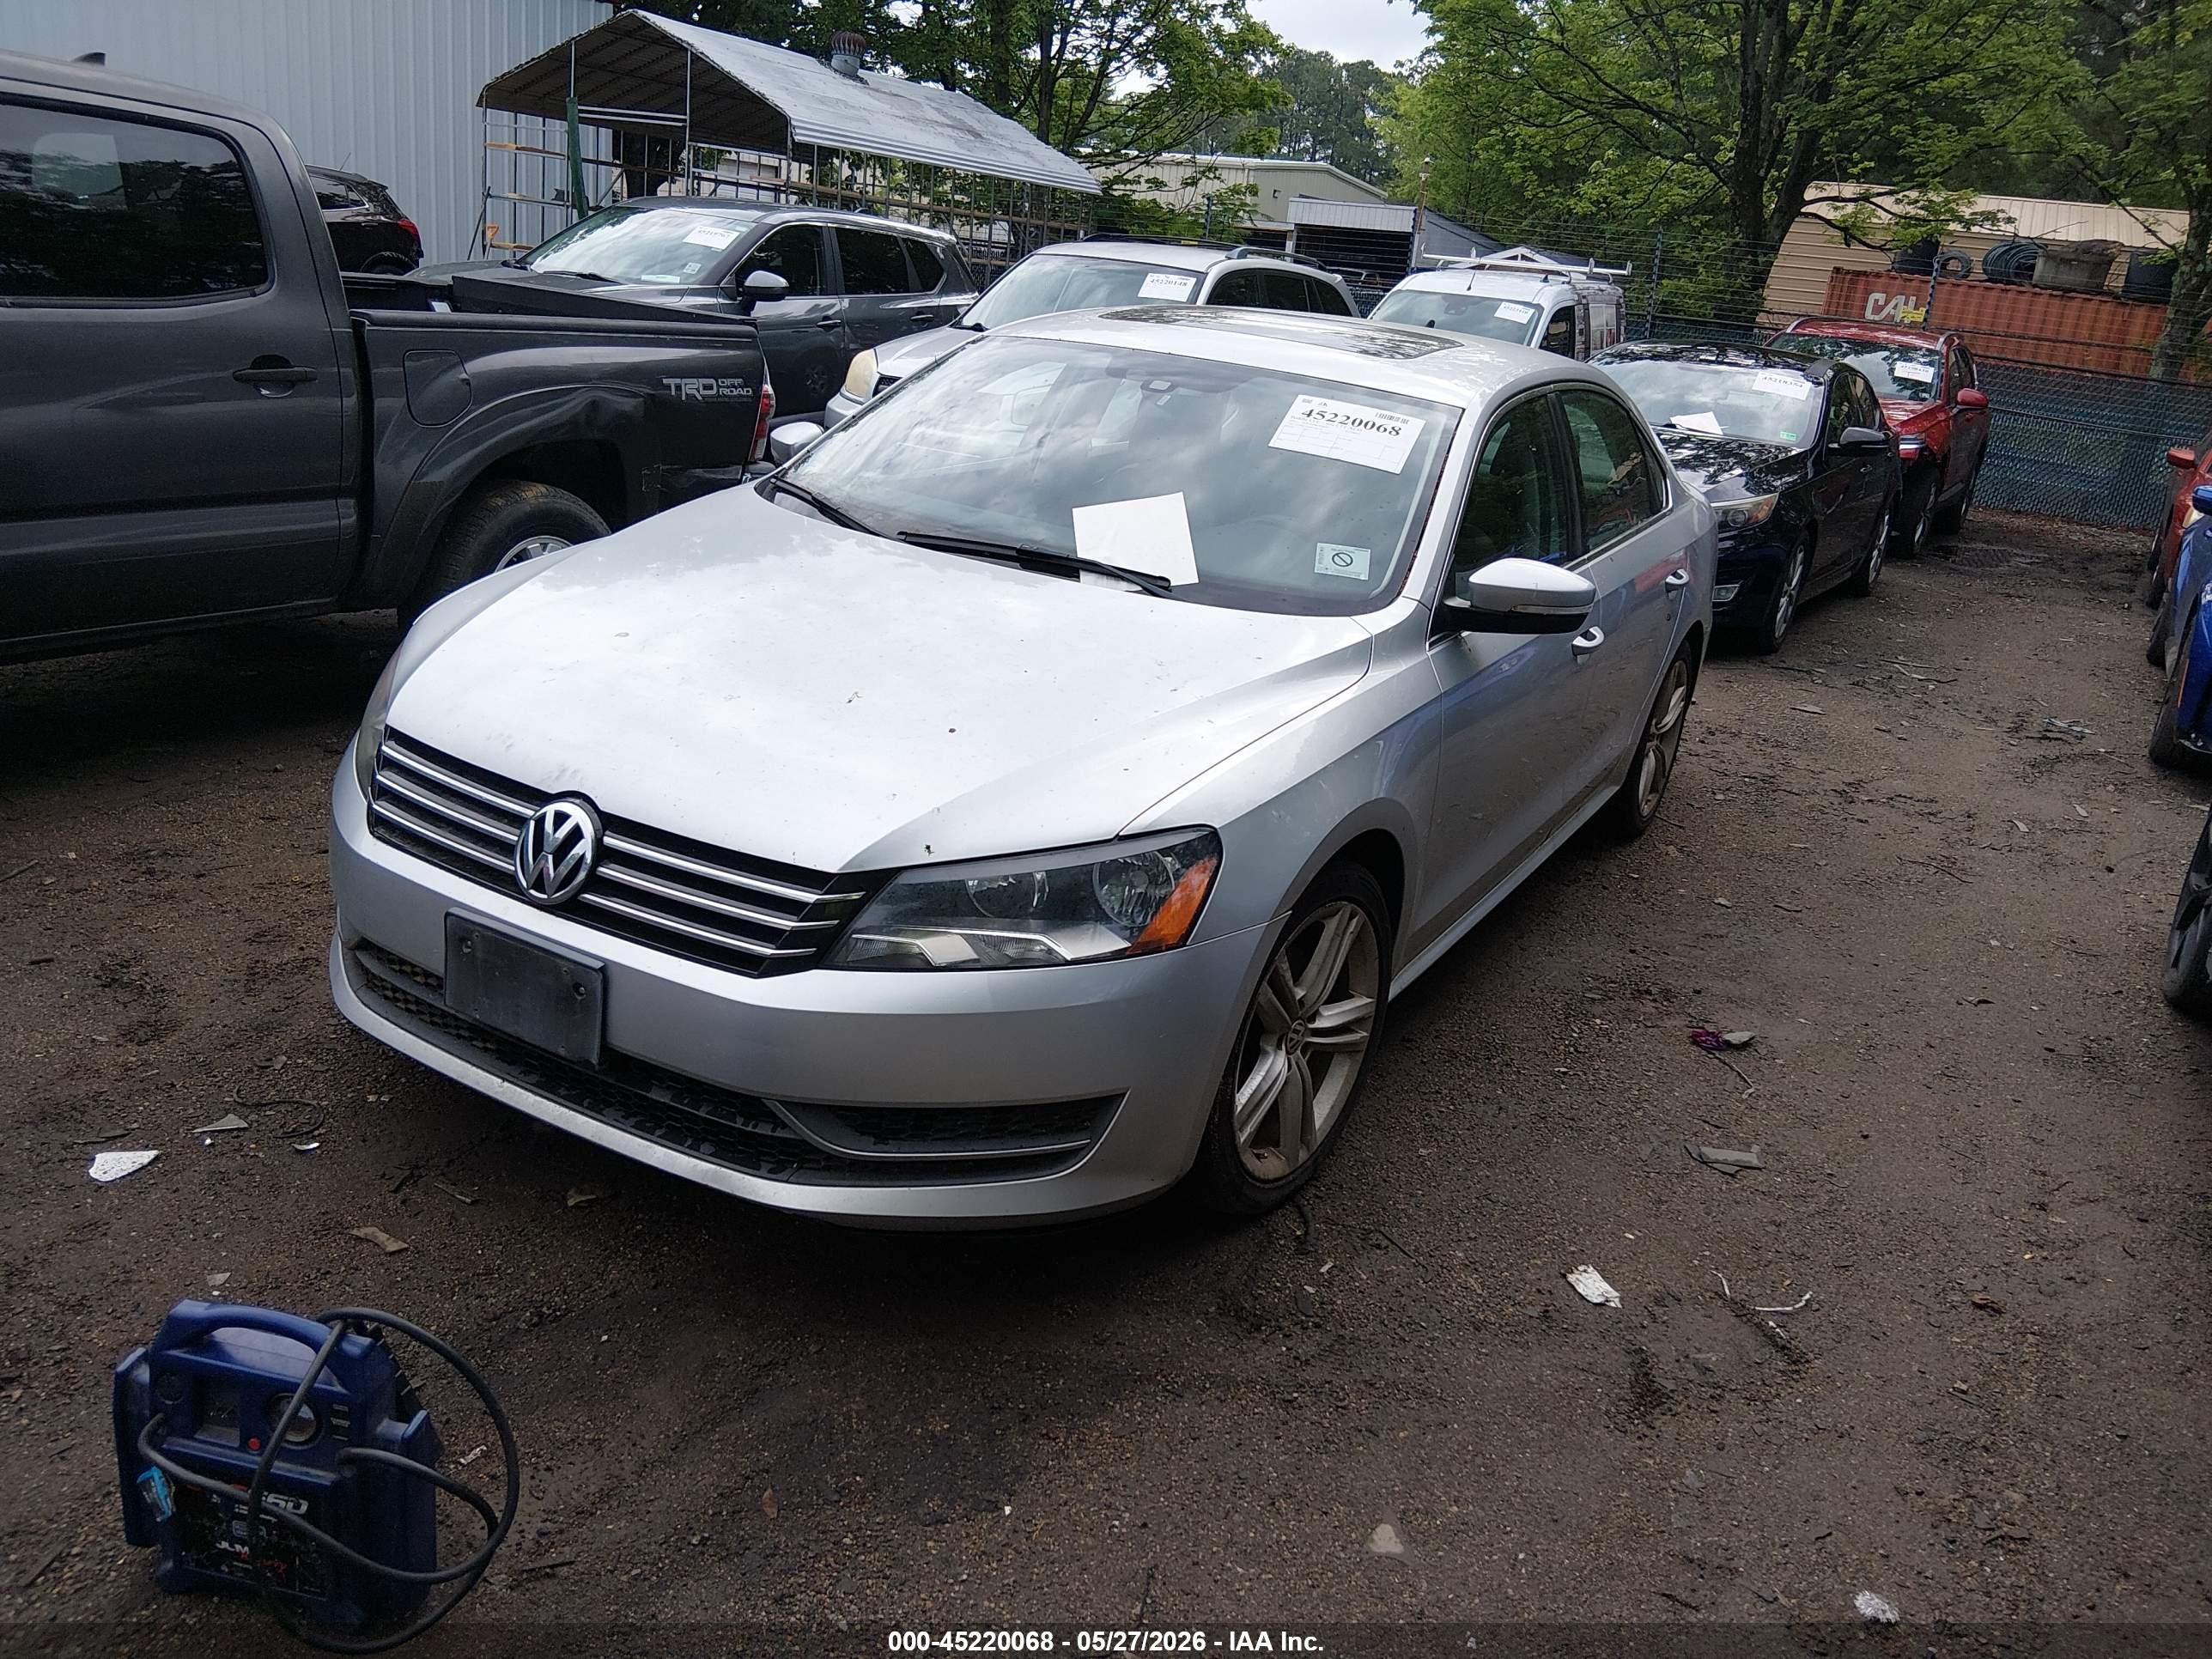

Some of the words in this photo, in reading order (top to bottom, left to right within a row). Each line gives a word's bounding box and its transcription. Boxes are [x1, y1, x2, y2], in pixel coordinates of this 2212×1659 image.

[662, 378, 716, 401] TRD
[718, 378, 744, 386] OFF
[1301, 408, 1402, 437] 45220068
[519, 804, 592, 900] VW
